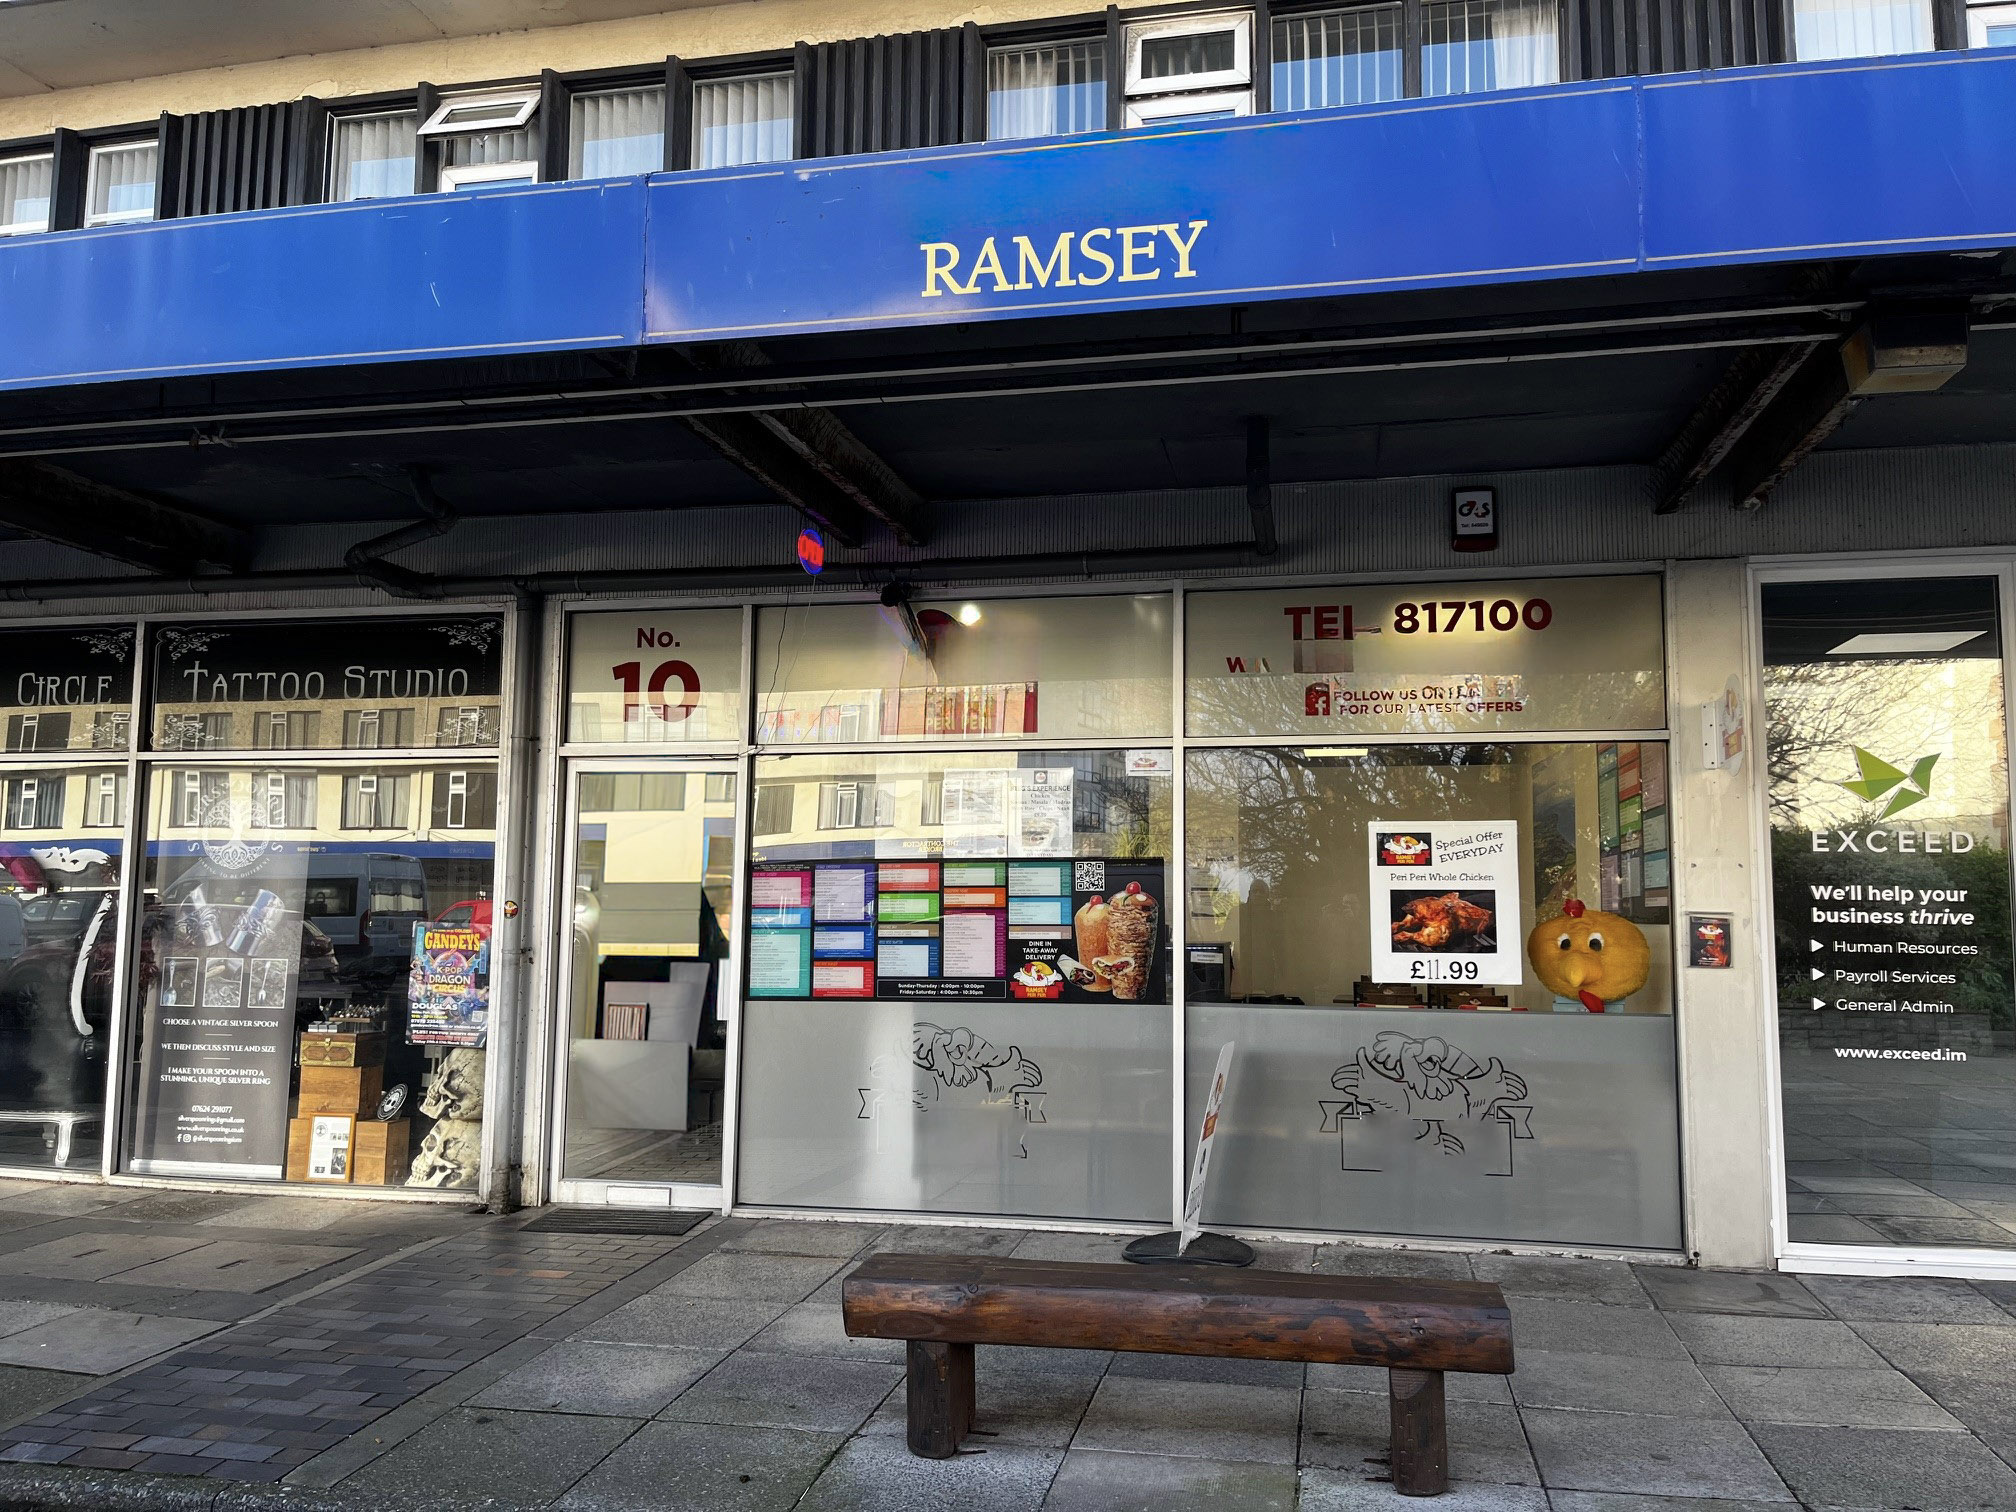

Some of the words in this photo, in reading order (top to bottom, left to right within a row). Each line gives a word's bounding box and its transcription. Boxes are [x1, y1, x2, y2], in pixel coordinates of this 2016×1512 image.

[920, 219, 1208, 298] RAMSEY
[1458, 501, 1490, 518] G4S
[1393, 598, 1553, 634] 817100
[637, 627, 681, 648] No.
[17, 672, 113, 706] CIRCLE
[183, 660, 325, 703] TATTOO
[344, 665, 469, 700] STUDIO
[612, 659, 701, 723] 10
[1334, 690, 1394, 701] FOLLOW
[1399, 689, 1418, 700] US
[1340, 704, 1369, 715] FOR
[1373, 703, 1403, 715] OUR
[1408, 702, 1461, 714] LATEST
[1465, 701, 1524, 713] OFFERS
[1435, 835, 1473, 851] Special
[1475, 831, 1504, 843] Offer
[1811, 830, 1974, 854] EXCEED
[1438, 843, 1505, 863] EVERYDAY
[1390, 873, 1407, 881] Peri
[1409, 873, 1426, 881] Peri
[1429, 873, 1457, 881] Whole
[1459, 873, 1494, 881] Chicken
[1810, 885, 1862, 900] We'll
[1868, 885, 1914, 905] help
[1919, 889, 1968, 905] your
[1811, 907, 1904, 923] business
[1909, 908, 1975, 925] thrive
[424, 932, 481, 952] GANDEYS
[1833, 940, 1893, 954] Human
[1896, 941, 1978, 955] Resources
[1410, 959, 1479, 980] £11.99
[1834, 969, 1888, 985] Payroll
[1891, 970, 1957, 984] Services
[429, 975, 471, 985] DRAGON
[432, 984, 466, 993] CIRCUS
[411, 1002, 458, 1011] DOUGLAS
[1835, 998, 1897, 1012] General
[1900, 1000, 1954, 1013] Admin
[261, 1045, 276, 1053] SIZE
[1834, 1047, 1968, 1062] www.exceed.im
[192, 1067, 214, 1075] YOUR
[160, 1075, 198, 1083] STUNNING,
[198, 1076, 227, 1085] UNIQUE
